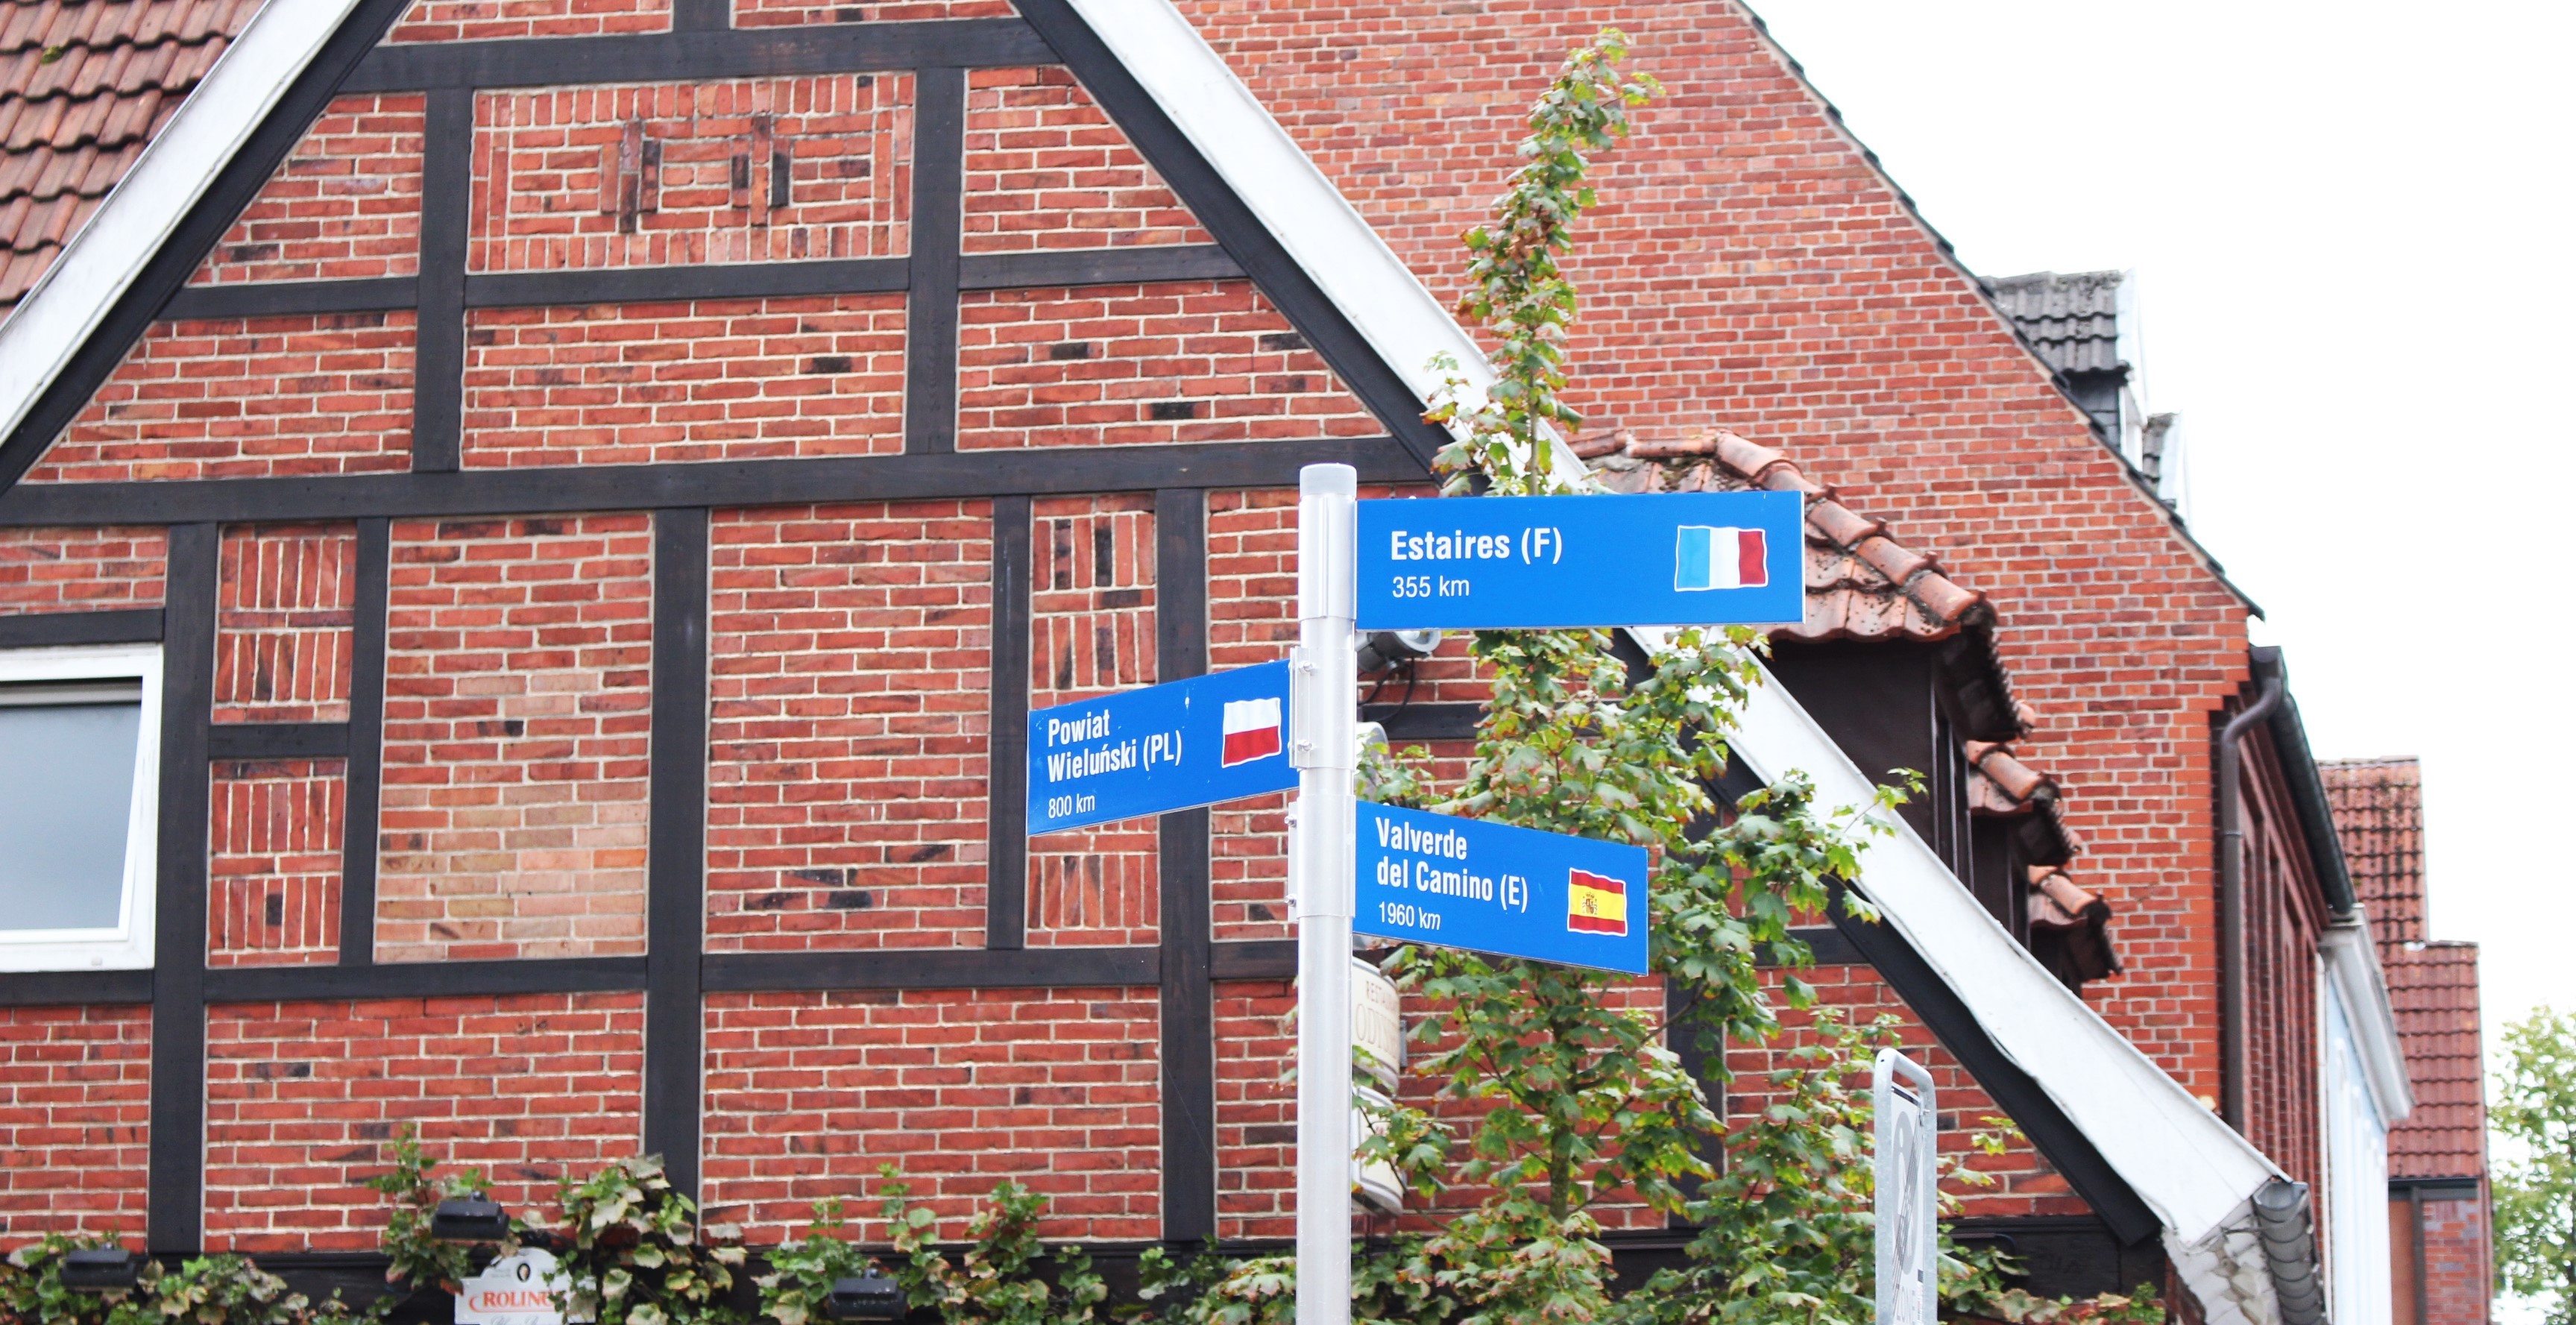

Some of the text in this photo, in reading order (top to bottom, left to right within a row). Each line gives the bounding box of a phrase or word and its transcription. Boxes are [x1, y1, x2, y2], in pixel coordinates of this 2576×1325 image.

[1391, 526, 1563, 565] Estaires (F)
[1392, 575, 1470, 598] 355 km
[1048, 709, 1109, 747] Powiat
[1047, 730, 1182, 783] Wieluński (PL)
[1048, 793, 1096, 819] 800 km
[1375, 816, 1468, 861] Valverde
[1376, 855, 1529, 914] del Camino (E)
[1379, 901, 1442, 931] 1960 km
